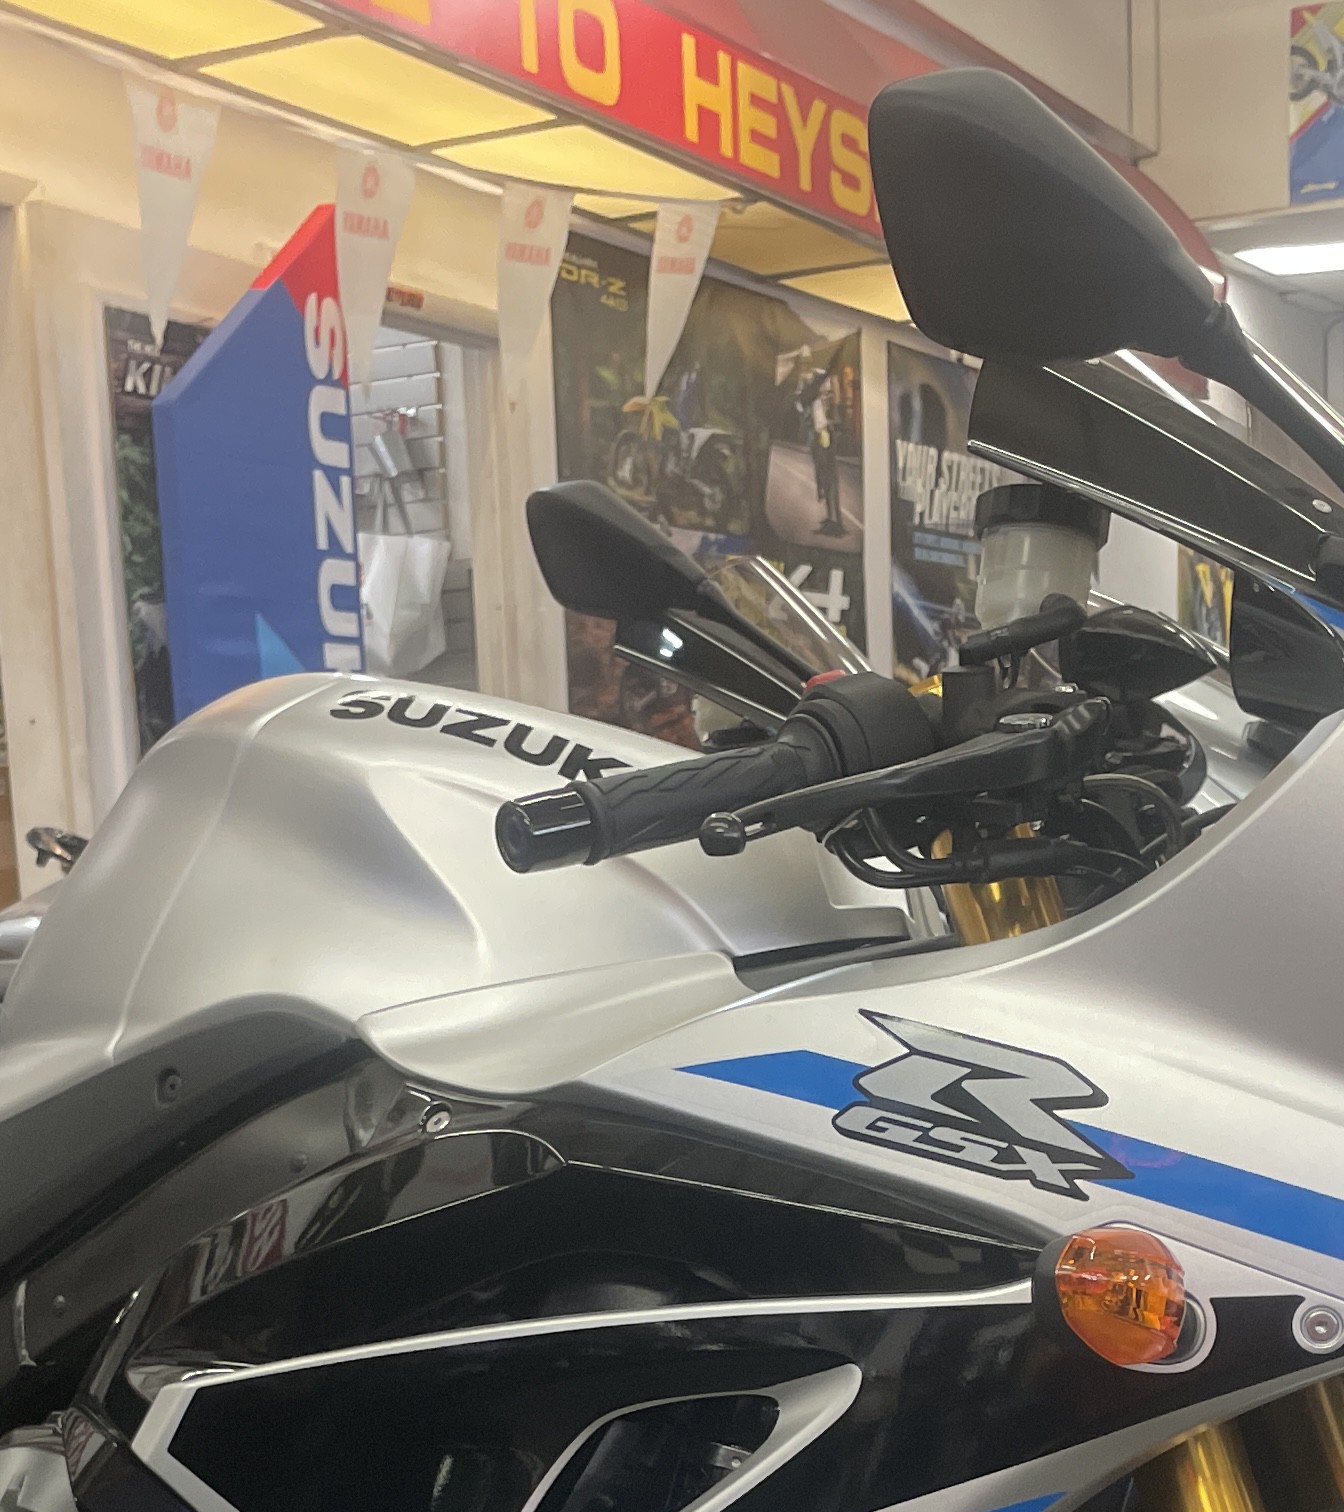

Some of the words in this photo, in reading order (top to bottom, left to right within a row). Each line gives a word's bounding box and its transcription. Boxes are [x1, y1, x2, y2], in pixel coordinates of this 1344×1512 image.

[682, 33, 882, 217] HEYS
[343, 211, 390, 240] YAMAHA
[329, 689, 634, 781] SUZUK
[831, 1102, 1096, 1200] GSX
